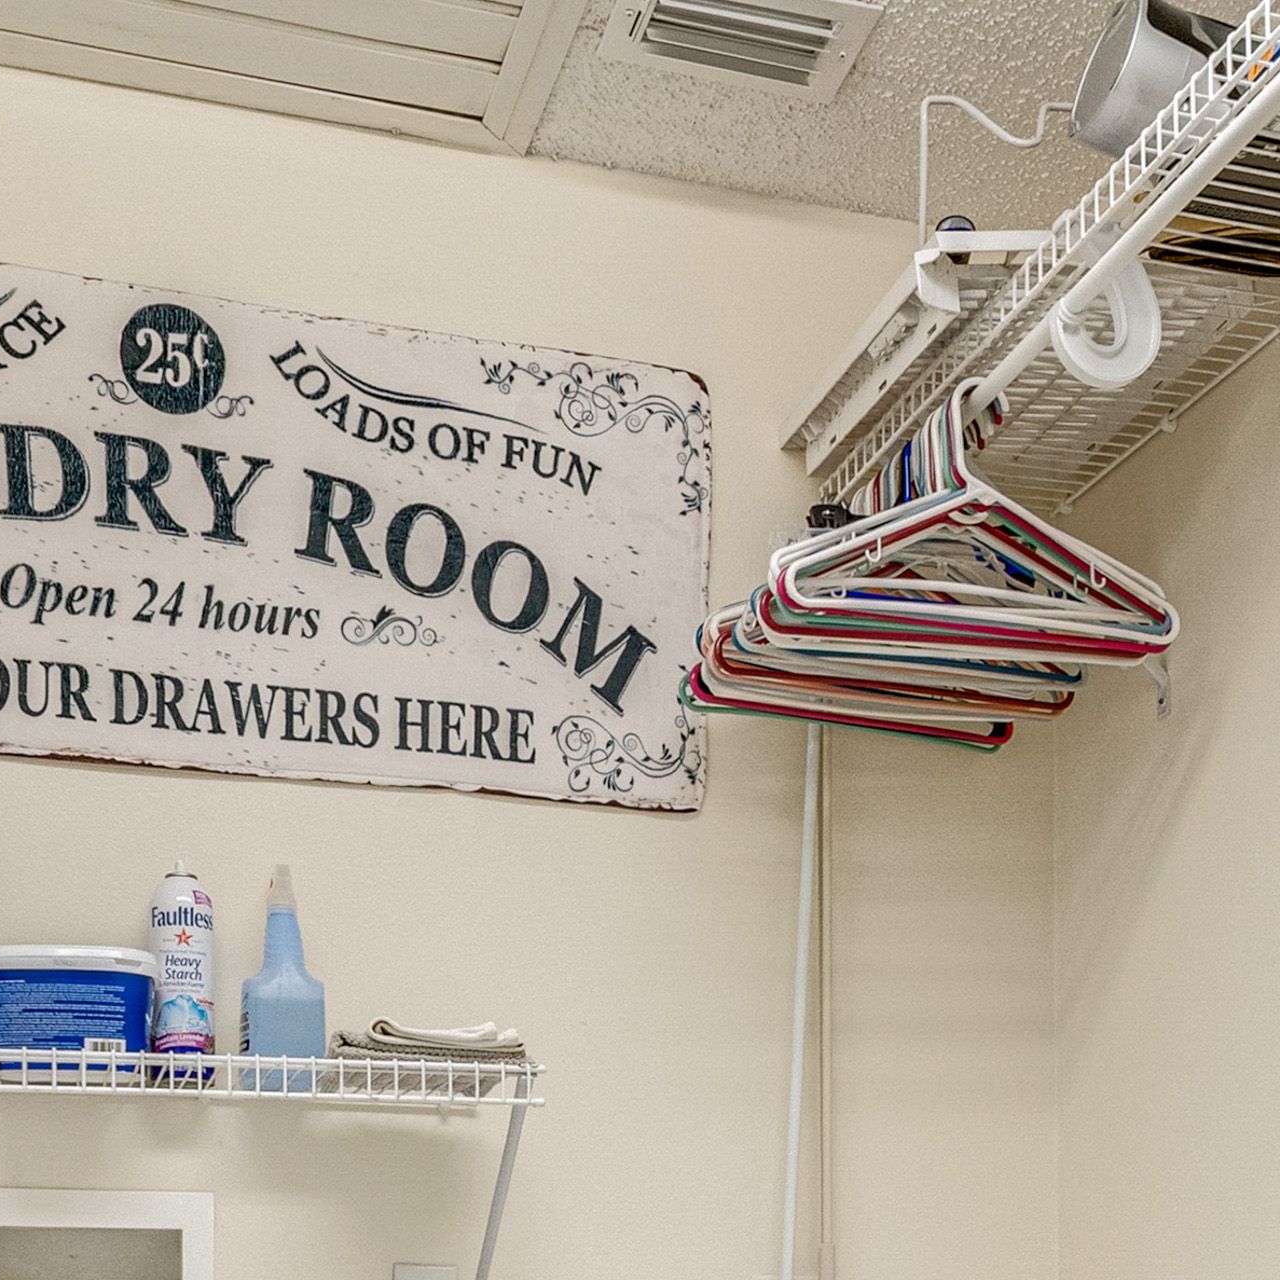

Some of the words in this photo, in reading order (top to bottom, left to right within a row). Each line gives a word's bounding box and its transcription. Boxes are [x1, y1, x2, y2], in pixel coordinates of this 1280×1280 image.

[269, 341, 416, 454] LOADS
[428, 422, 490, 465] OF
[502, 435, 602, 496] FUN
[0, 562, 116, 624] Open
[132, 577, 184, 627] 24
[198, 584, 321, 639] hours
[294, 467, 657, 716] ROOM
[109, 668, 380, 749] DRAWERS
[394, 696, 537, 764] HERE
[151, 906, 213, 931] Faultless
[165, 955, 201, 970] Heavy
[165, 968, 202, 980] Starch
